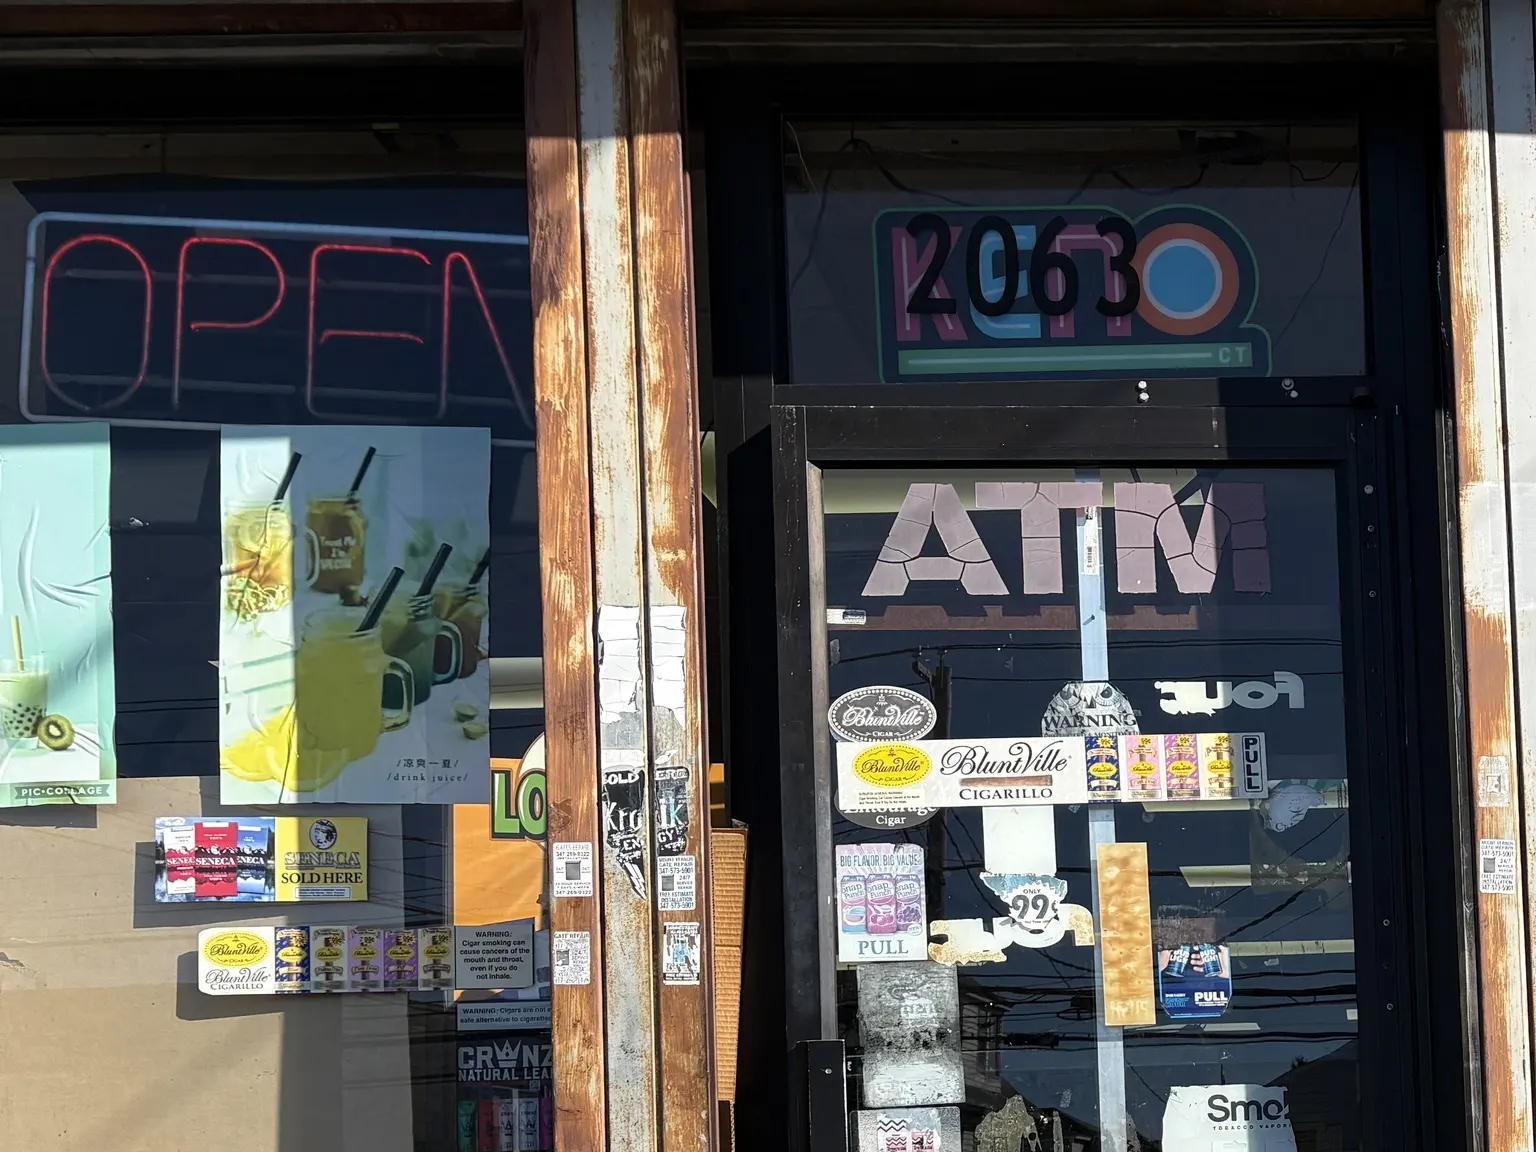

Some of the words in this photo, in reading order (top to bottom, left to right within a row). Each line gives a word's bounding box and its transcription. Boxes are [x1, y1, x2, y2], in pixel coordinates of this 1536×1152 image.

[906, 213, 1140, 317] 2063
[41, 234, 534, 430] OPEN
[1217, 347, 1246, 363] CT
[861, 482, 1272, 597] ATM
[842, 704, 924, 726] BluntVille
[1043, 713, 1137, 729] WARNING
[861, 757, 921, 774] BluntVille
[939, 741, 1069, 775] BluntVille
[1244, 737, 1260, 790] PULL
[959, 788, 1053, 800] CIGARILLO
[876, 815, 906, 826] Cigar
[196, 857, 236, 866] SENECA
[284, 851, 361, 867] SENECA
[840, 855, 851, 867] BIG
[883, 855, 895, 867] BIG
[281, 872, 320, 884] SOLD
[323, 872, 363, 884] HERE
[210, 940, 262, 956] BluntVille
[858, 939, 909, 955] PULL
[205, 967, 269, 984] BluntVille
[495, 965, 507, 973] you
[1194, 991, 1228, 1001] PULL
[500, 1007, 522, 1015] Cigars
[458, 1068, 519, 1082] NATURAL
[524, 1067, 552, 1080] LEA
